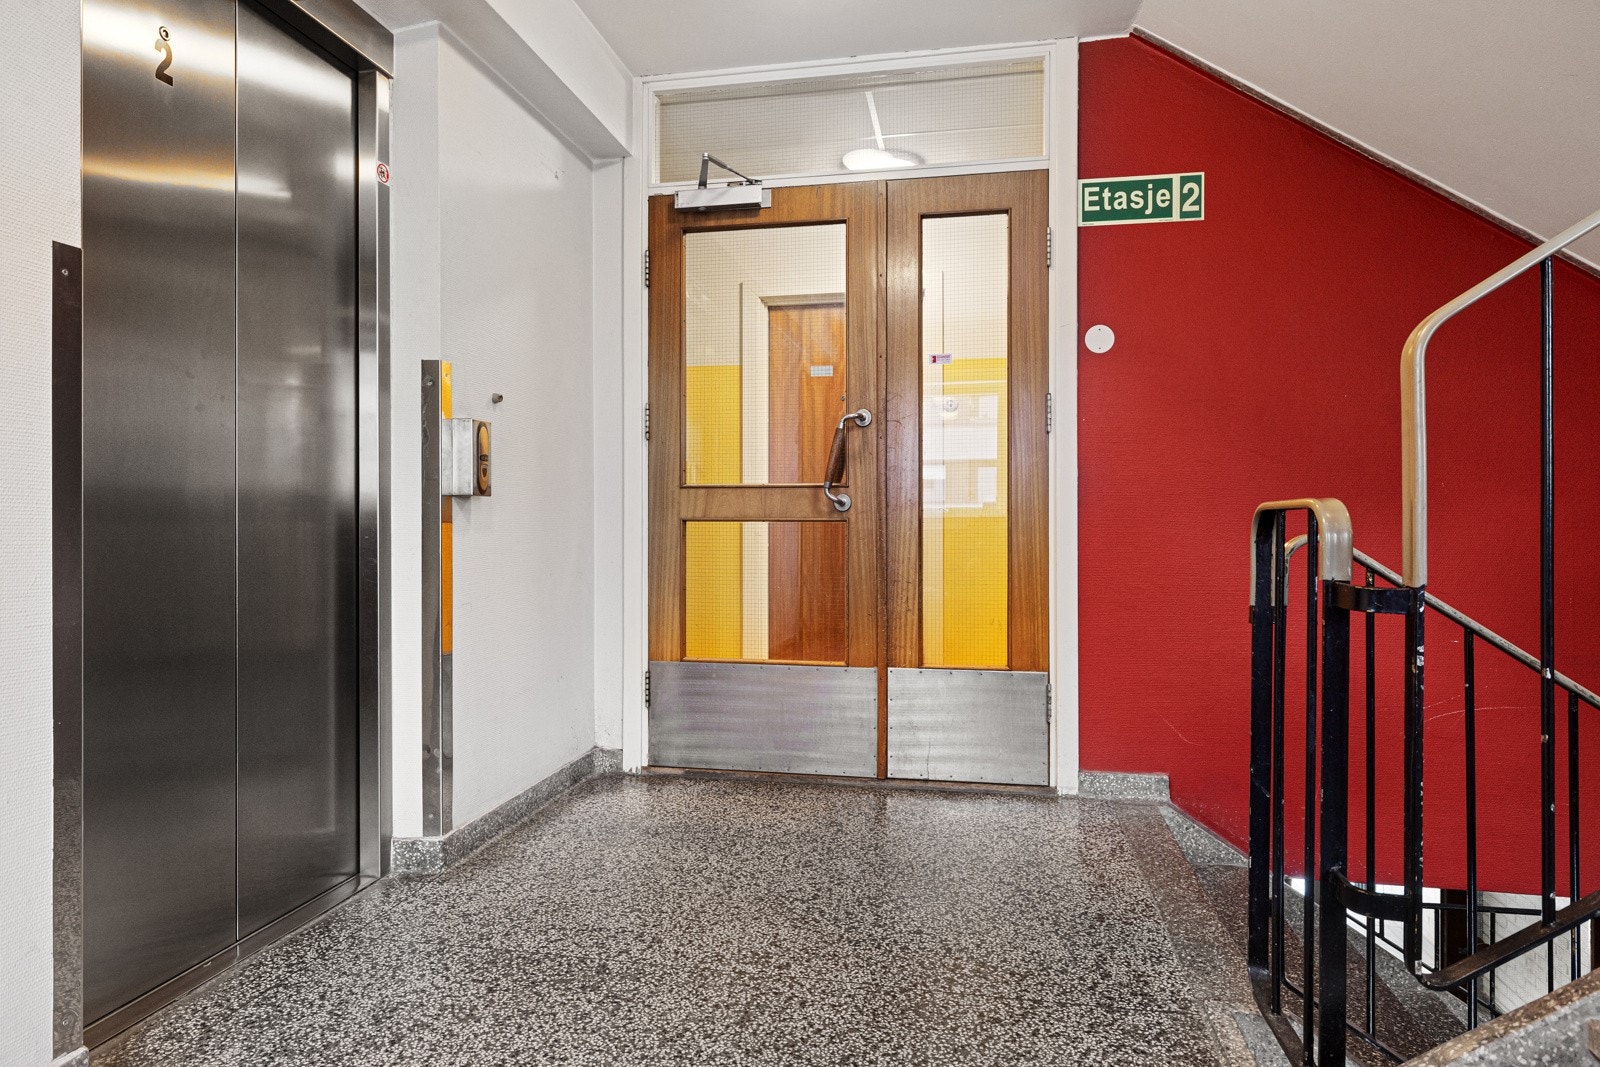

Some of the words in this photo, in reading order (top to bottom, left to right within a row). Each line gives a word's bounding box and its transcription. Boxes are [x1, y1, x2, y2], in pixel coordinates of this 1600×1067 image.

[154, 39, 173, 86] 2
[1084, 183, 1171, 215] Etasje
[1182, 182, 1200, 212] 2
